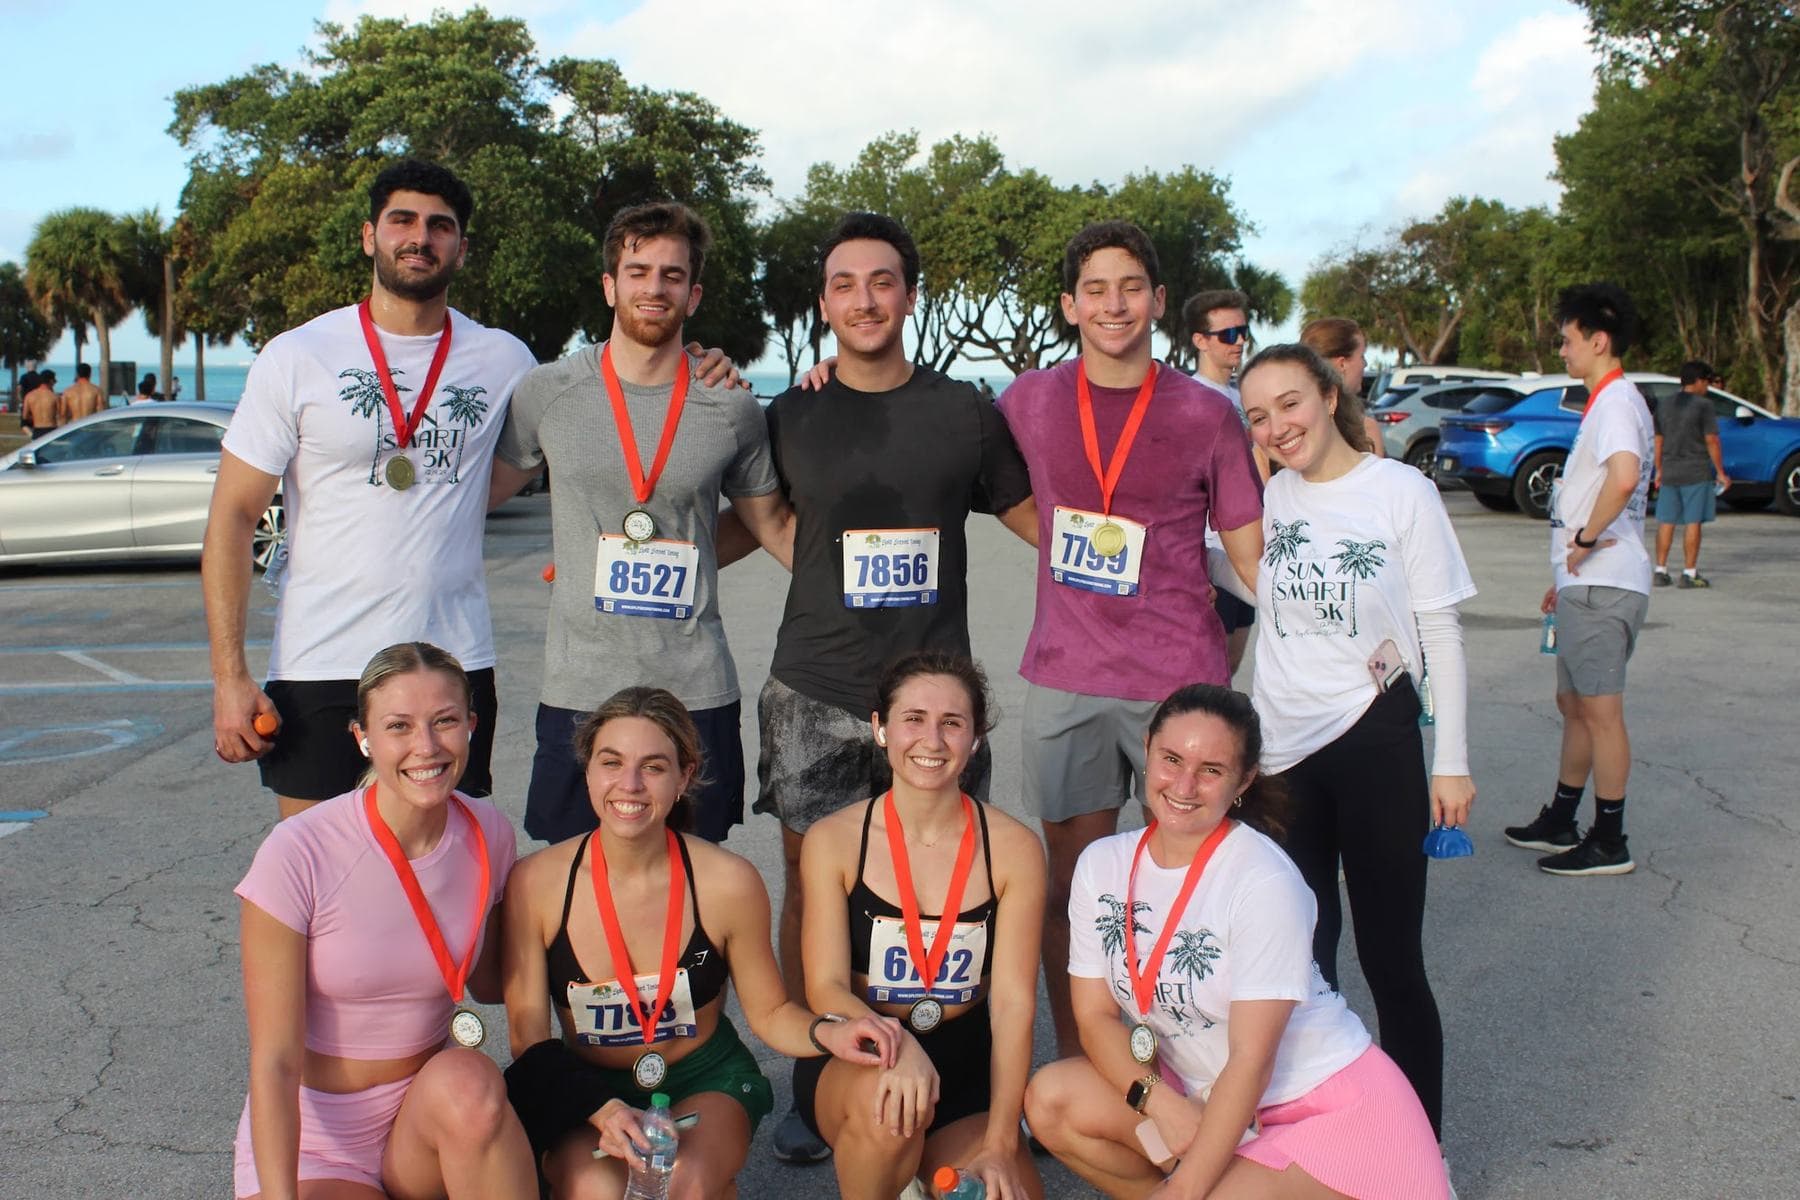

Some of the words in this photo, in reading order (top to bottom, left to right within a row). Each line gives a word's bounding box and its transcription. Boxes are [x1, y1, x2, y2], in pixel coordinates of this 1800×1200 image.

[382, 429, 463, 451] SART
[423, 449, 453, 468] 5K
[609, 560, 687, 598] 8527
[854, 552, 928, 587] 7856
[1285, 561, 1326, 581] SUN
[1275, 581, 1350, 601] SMART
[1314, 602, 1344, 621] 5K
[1115, 980, 1187, 1004] SART
